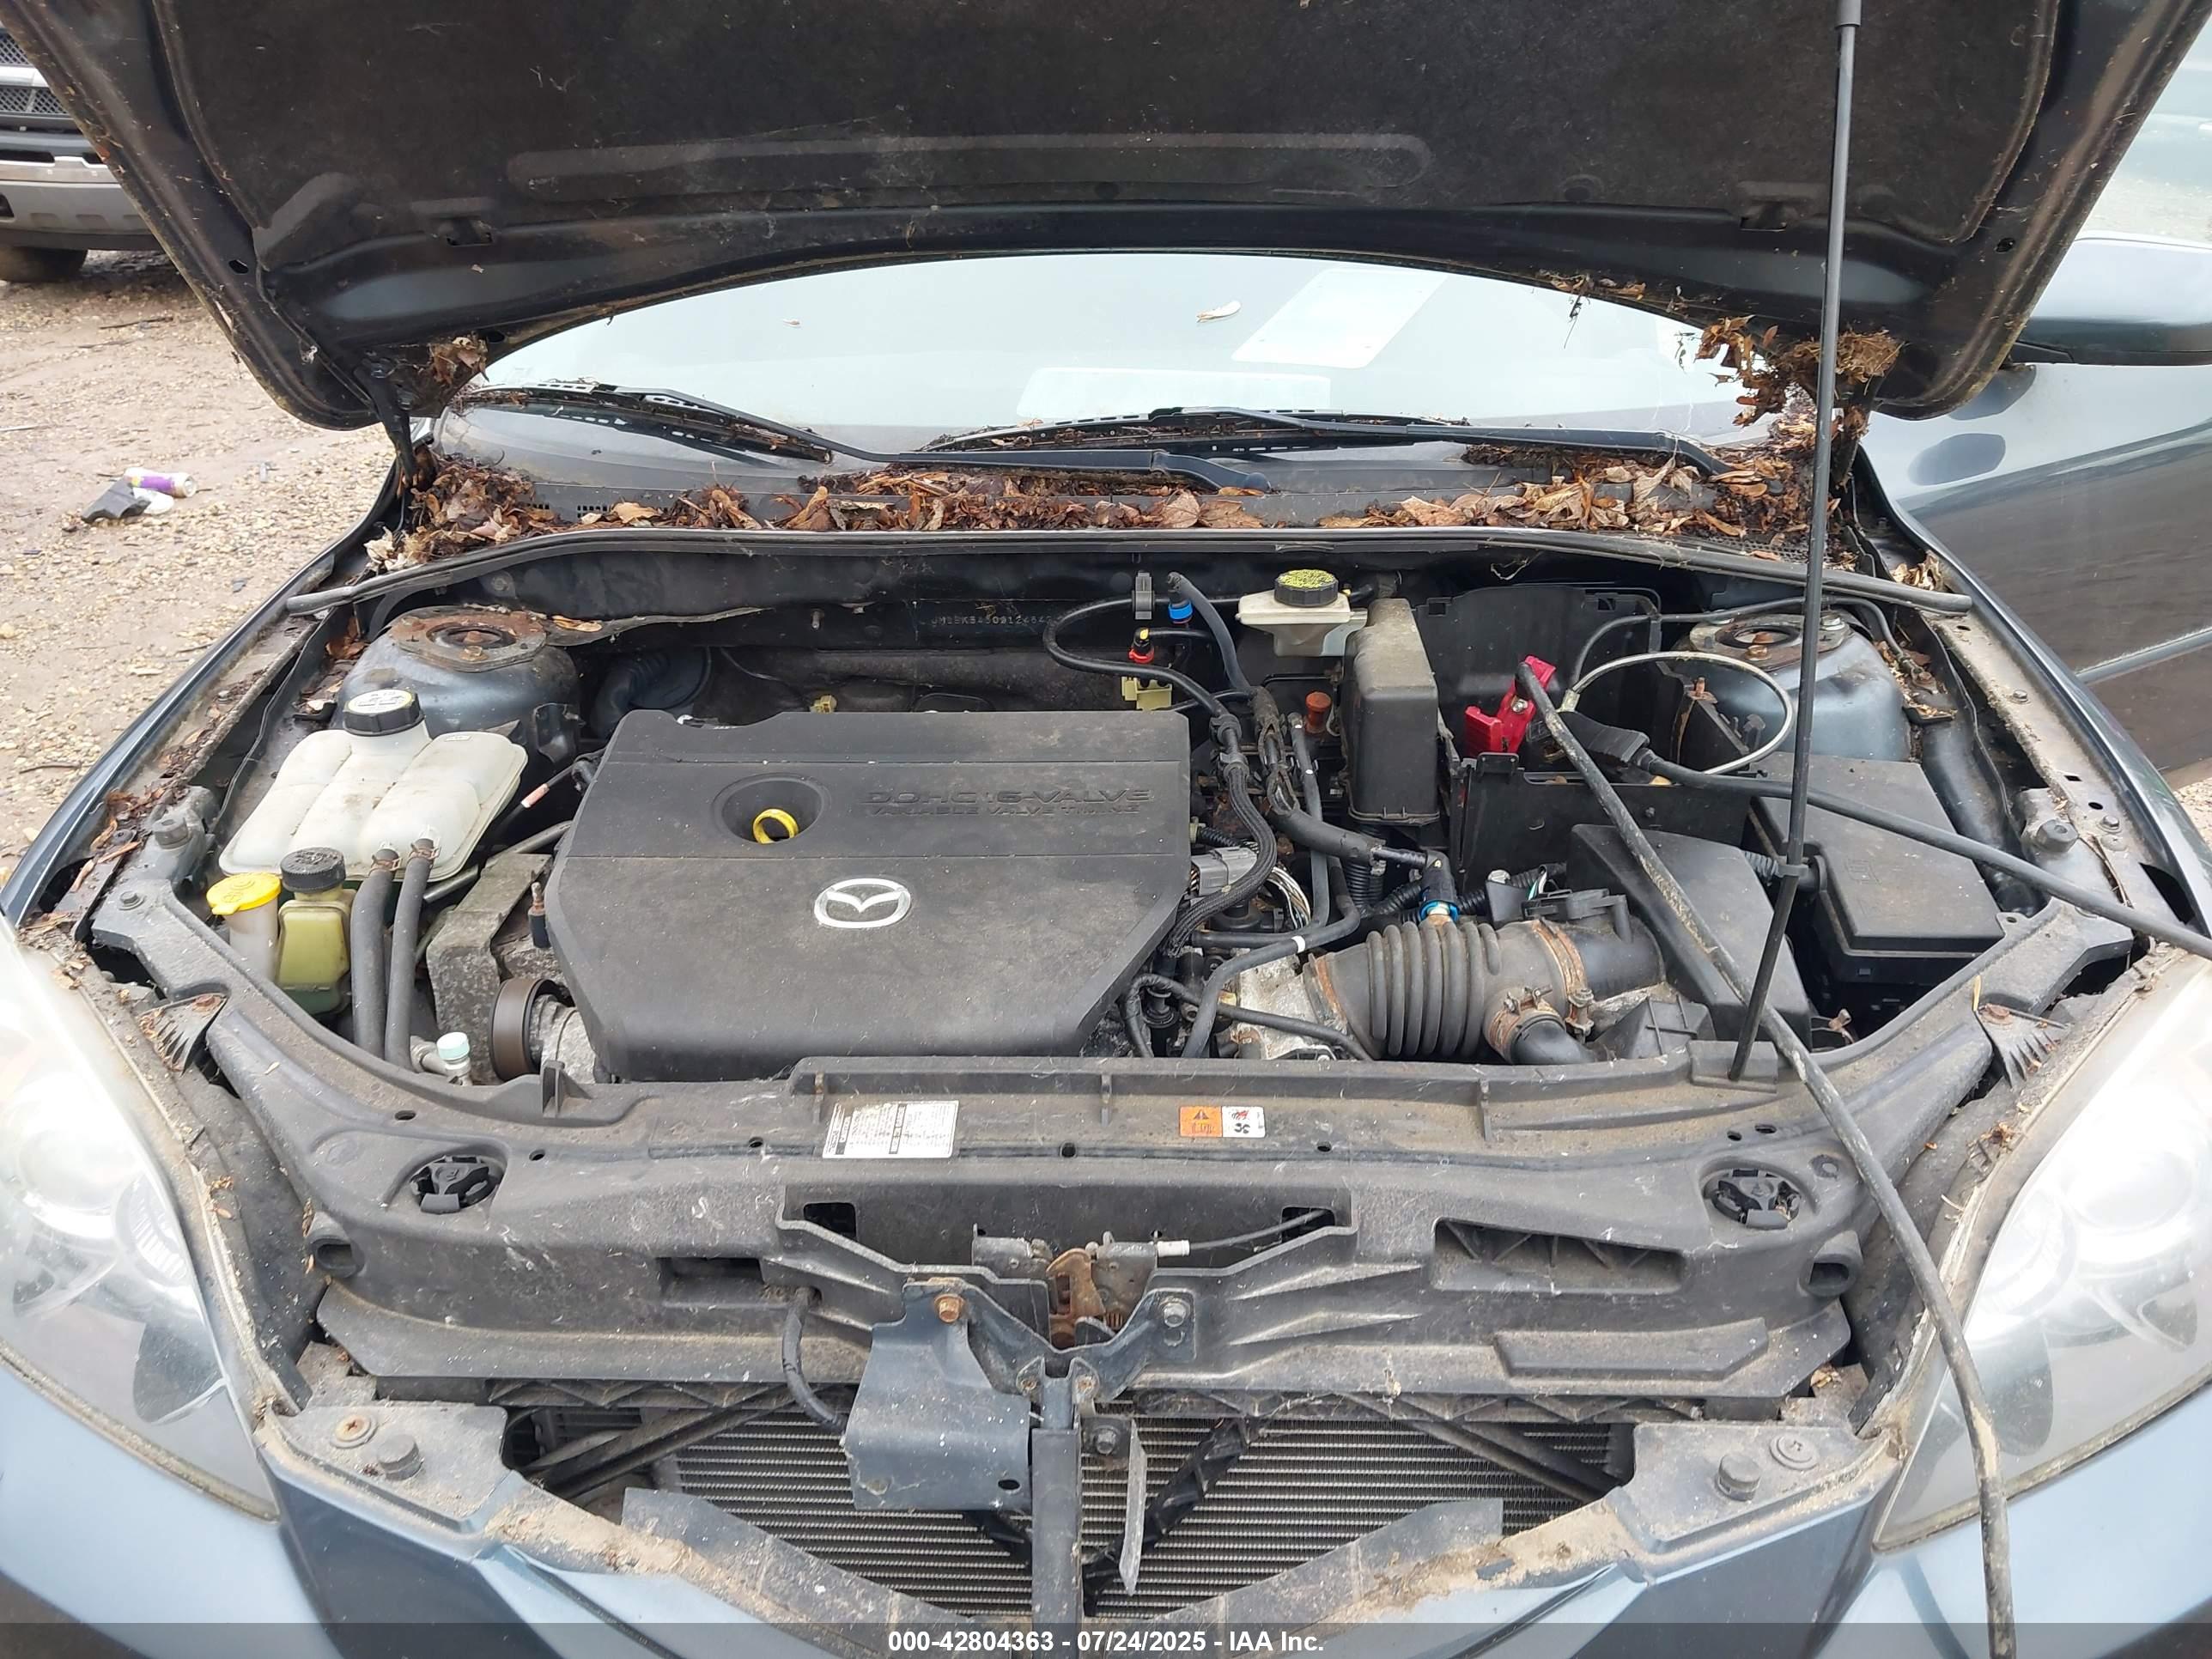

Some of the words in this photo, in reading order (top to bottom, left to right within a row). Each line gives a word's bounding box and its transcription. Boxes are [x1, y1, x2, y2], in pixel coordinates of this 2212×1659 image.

[862, 791, 977, 805] DOHC
[988, 805, 1056, 816] VALVE
[1060, 805, 1141, 815] TIMING
